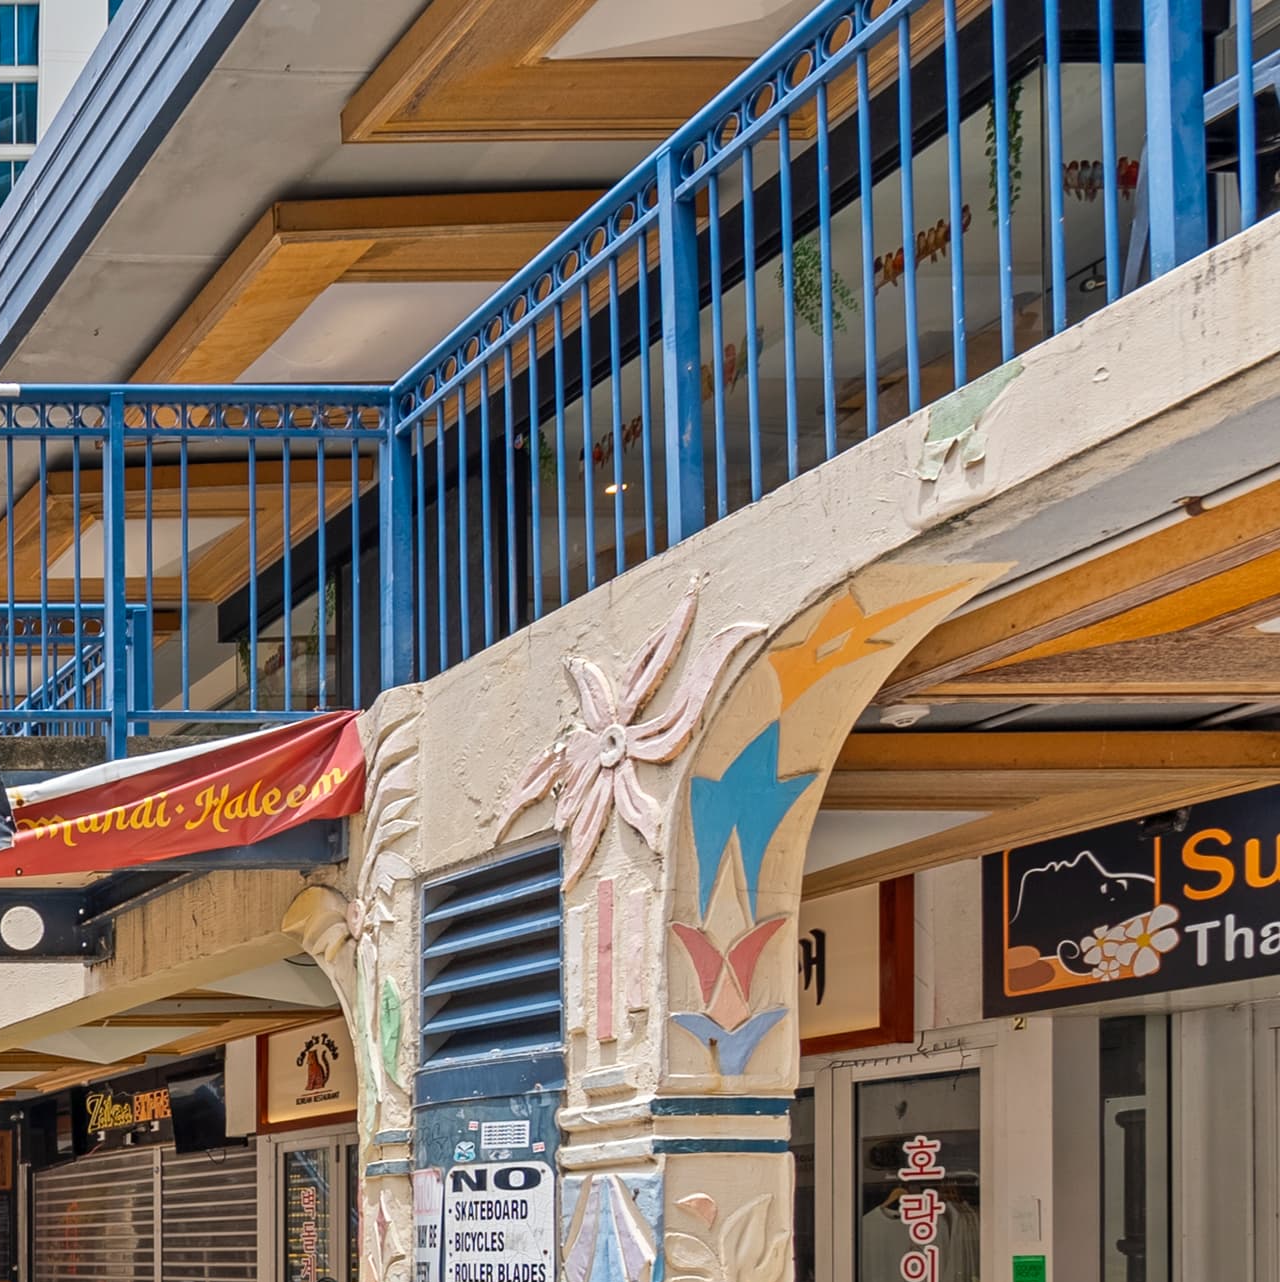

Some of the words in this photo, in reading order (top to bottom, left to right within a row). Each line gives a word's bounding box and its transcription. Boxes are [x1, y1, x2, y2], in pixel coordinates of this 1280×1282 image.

[183, 765, 349, 834] Haleem
[1013, 1016, 1026, 1031] 2
[313, 1091, 340, 1104] RESTAURANT
[451, 1166, 542, 1193] NO
[455, 1199, 528, 1221] SKATEBOARD
[428, 1224, 438, 1249] BE
[455, 1231, 505, 1253] BICYCLES
